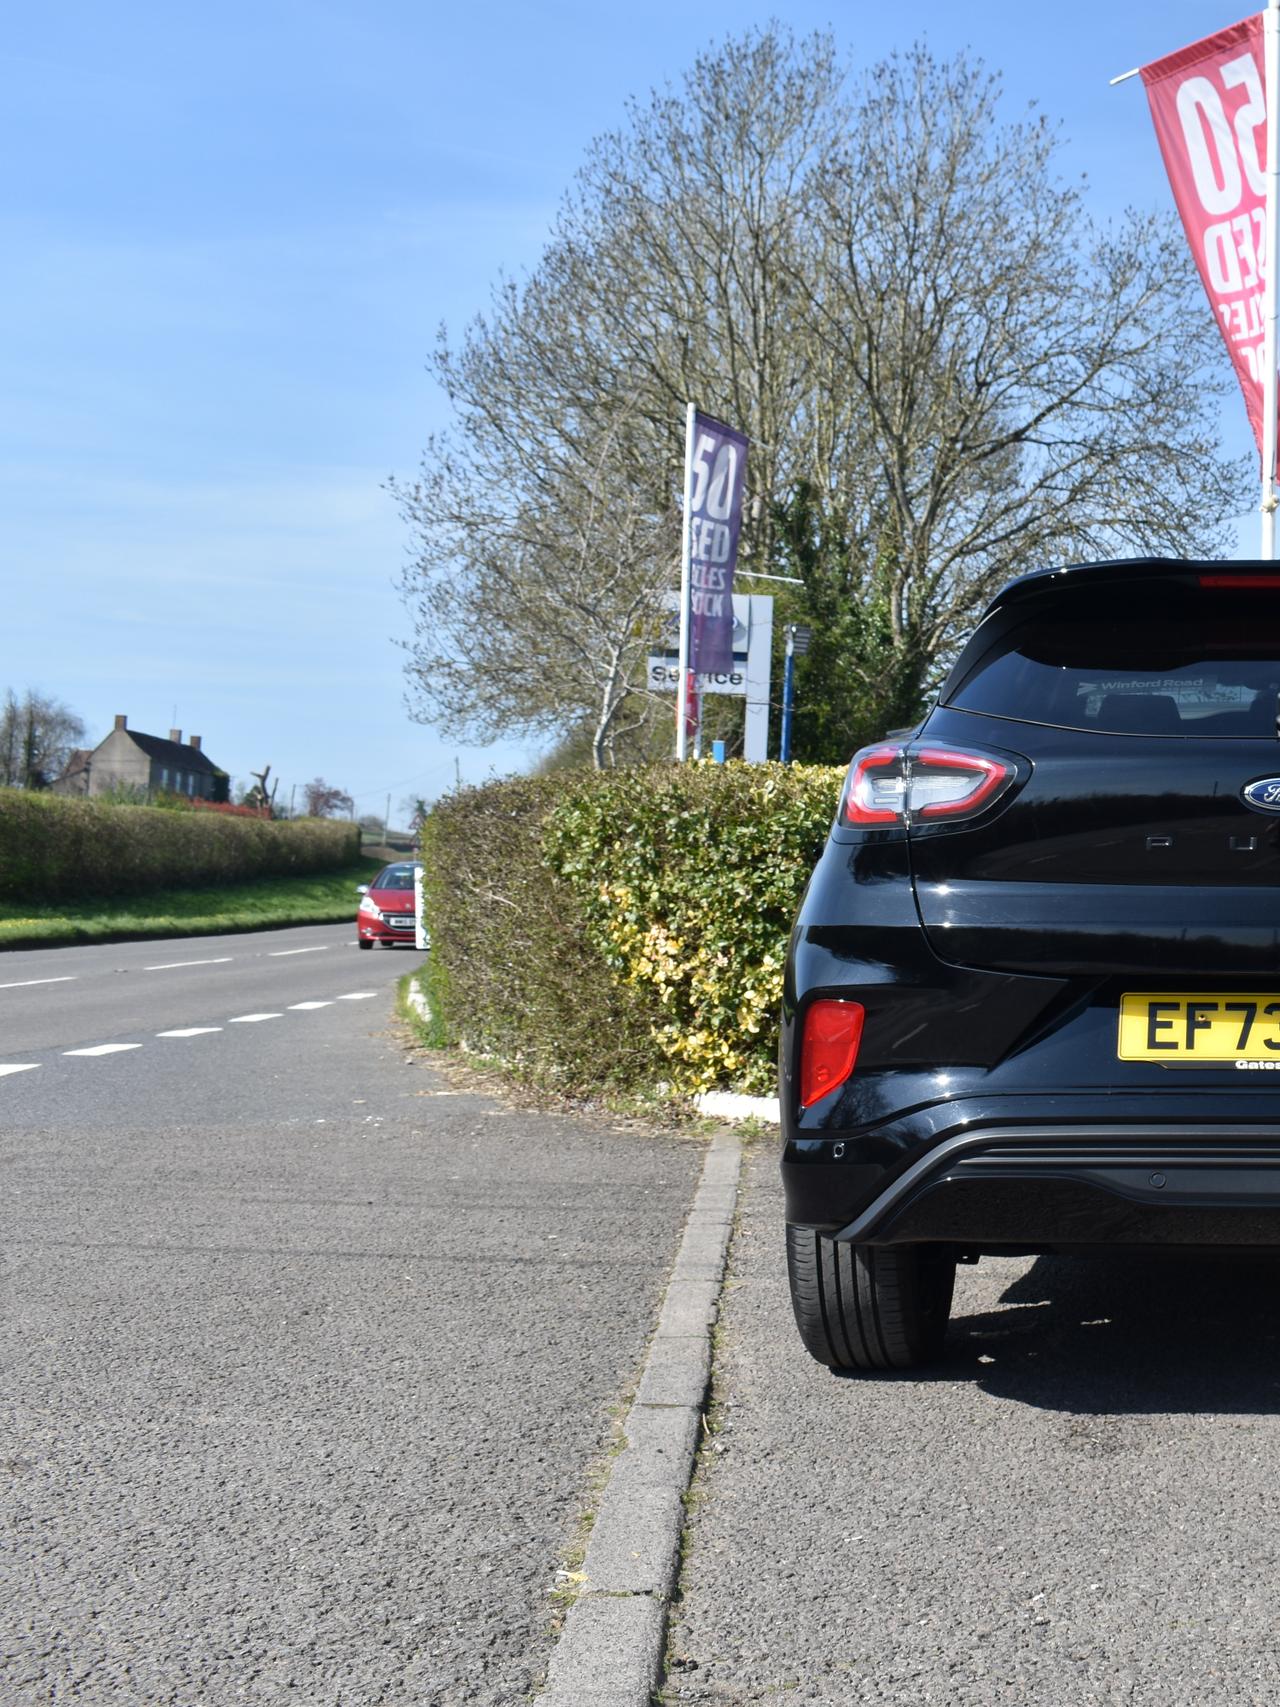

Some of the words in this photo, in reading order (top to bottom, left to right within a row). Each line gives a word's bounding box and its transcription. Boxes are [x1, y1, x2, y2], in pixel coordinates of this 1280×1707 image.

[691, 433, 737, 521] 50
[691, 516, 731, 563] SED
[1101, 679, 1161, 690] Winford
[1162, 679, 1204, 688] Road
